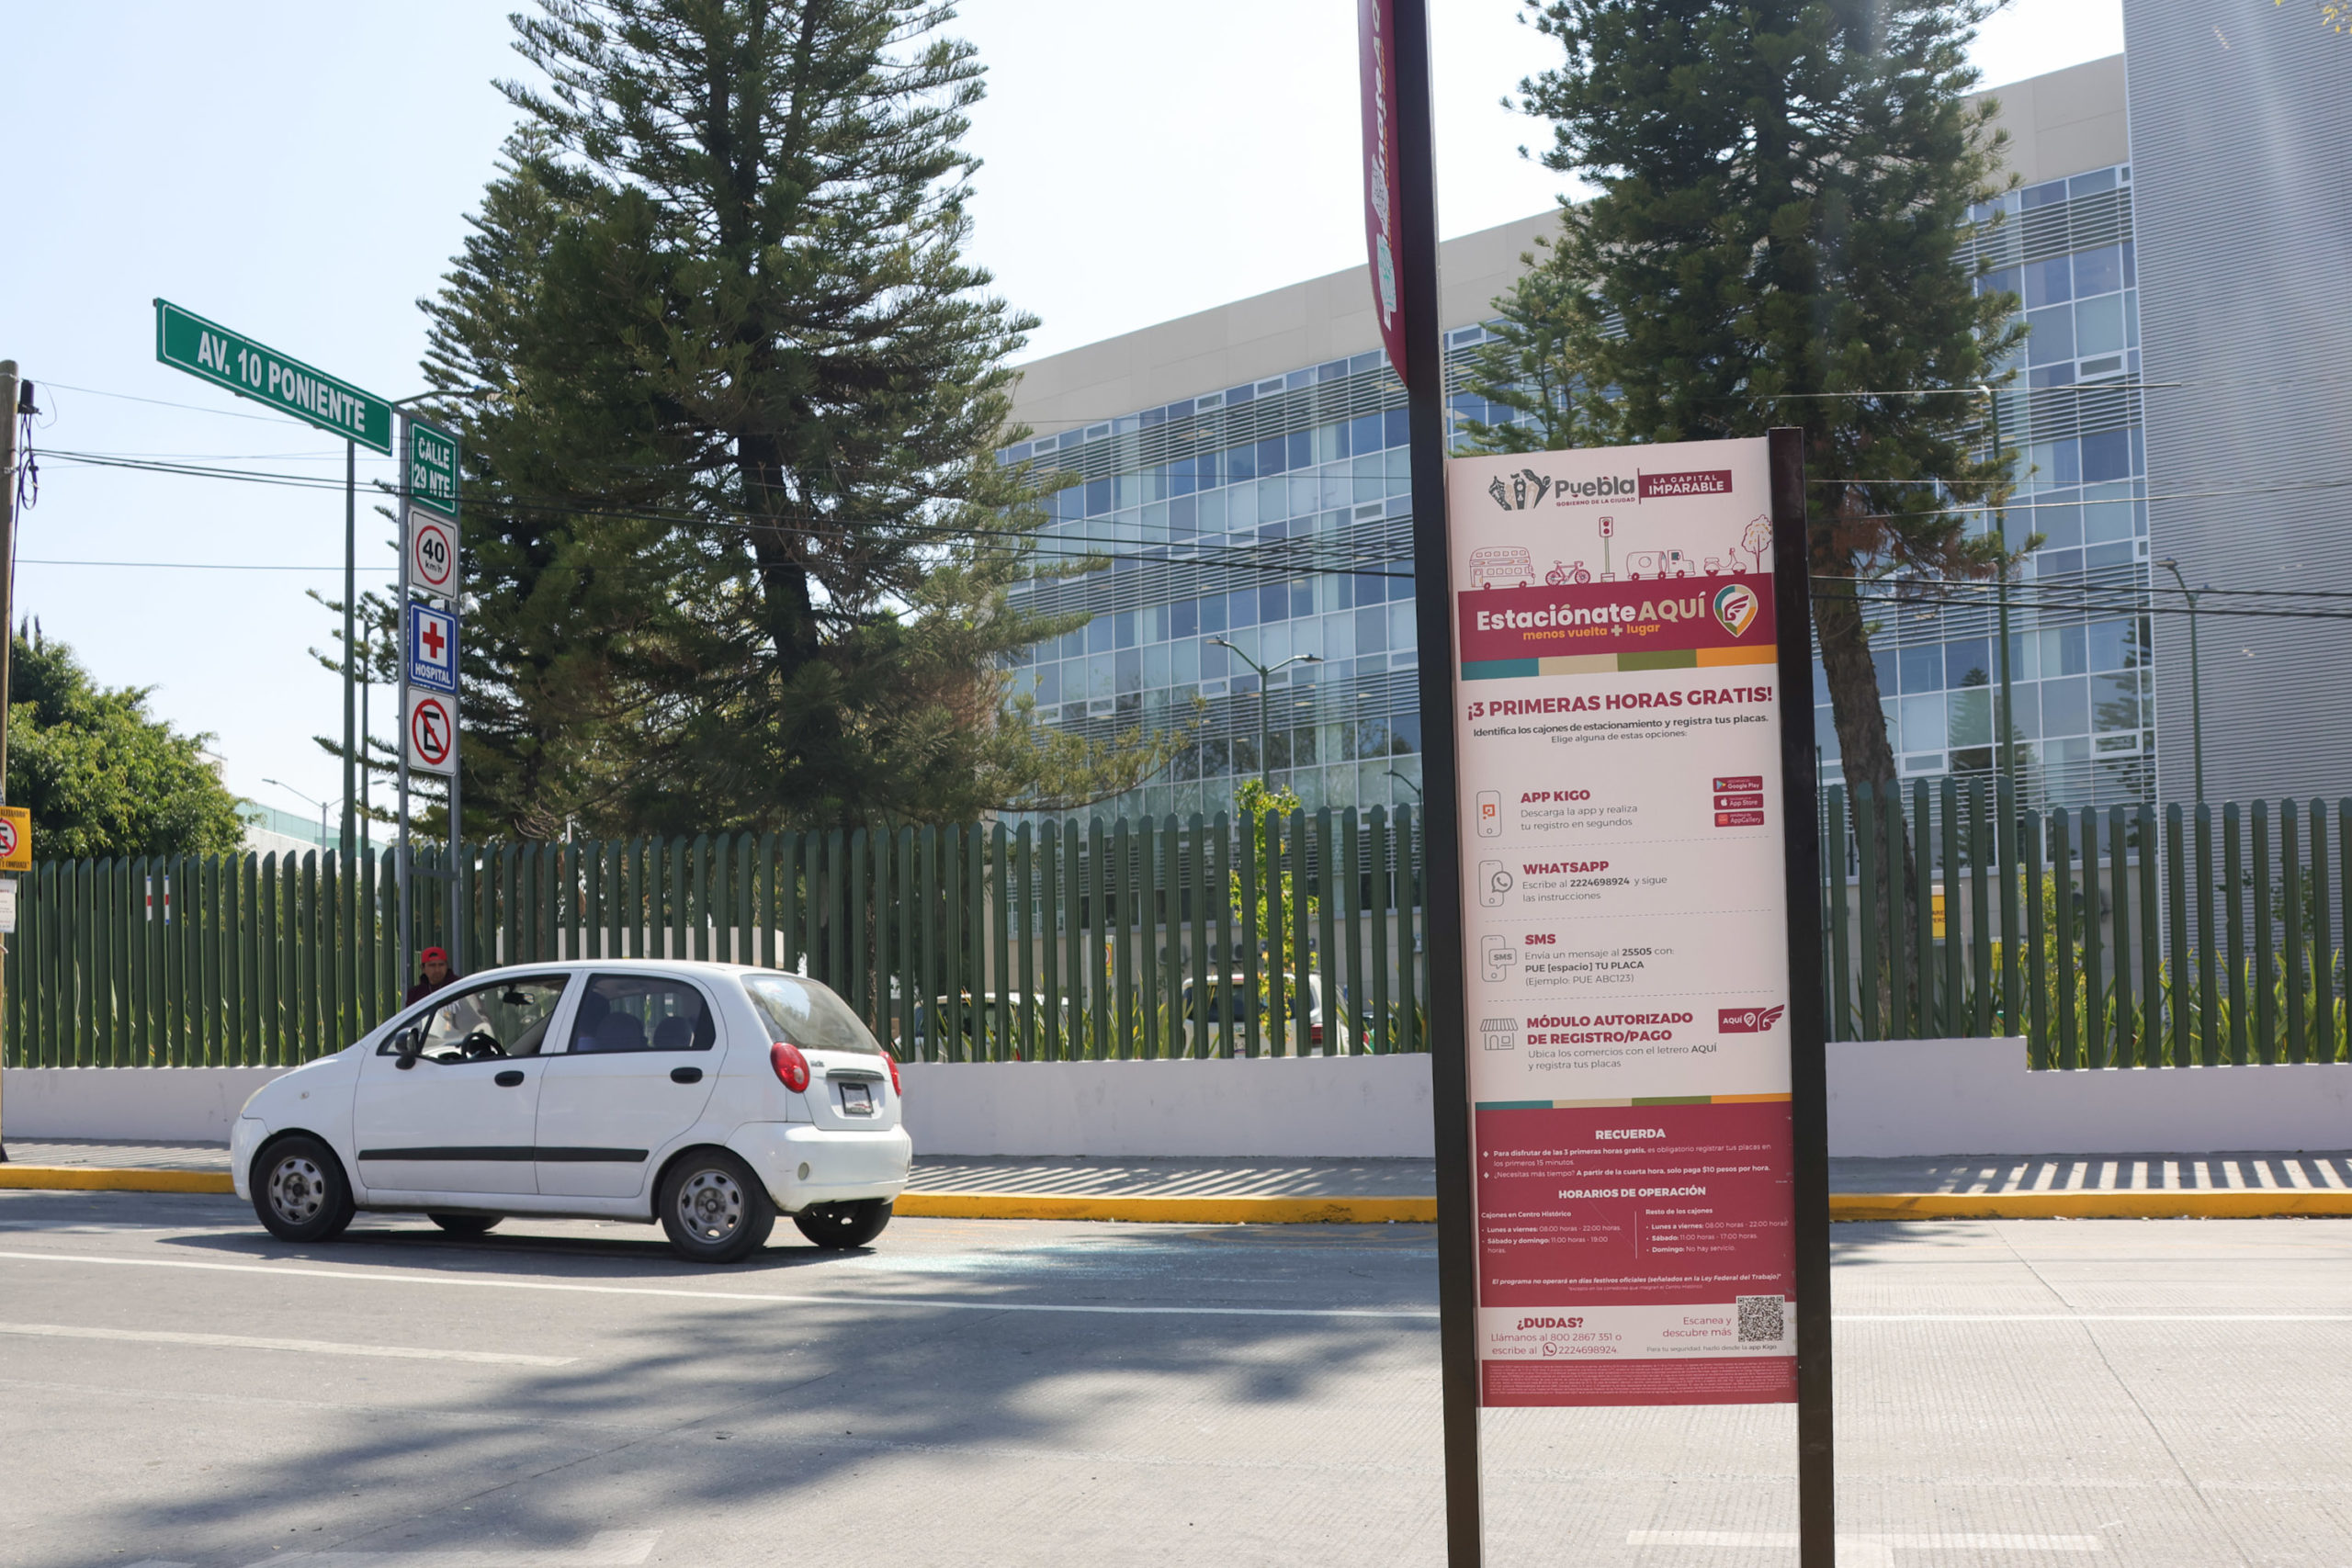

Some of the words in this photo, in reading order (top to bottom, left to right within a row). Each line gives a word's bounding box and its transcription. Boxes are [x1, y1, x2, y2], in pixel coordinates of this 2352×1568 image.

[198, 331, 230, 375] AV.
[238, 348, 262, 388] 10
[268, 360, 366, 433] PONIENTE
[418, 437, 449, 469] CALLE
[413, 464, 427, 490] 29
[429, 471, 454, 499] NTE.
[1670, 475, 1717, 483] CAPITAL
[1555, 476, 1635, 499] Puebla
[1648, 480, 1724, 495] IMPARABLE
[423, 538, 445, 564] 40
[425, 562, 443, 574] km/h
[1523, 630, 1566, 640] menos
[1567, 626, 1607, 637] vuelta
[1627, 624, 1660, 637] lugar
[415, 662, 451, 684] HOSPITAL
[1468, 702, 1485, 721] ¡3
[1489, 695, 1600, 716] PRIMERAS
[1606, 691, 1682, 710] HORAS
[1687, 686, 1772, 705] GRATIS!
[1474, 727, 1517, 737] Identifica
[1518, 726, 1532, 734] los
[1532, 724, 1568, 735] cajones
[1569, 723, 1582, 731] de
[1583, 719, 1663, 731] estacionamiento
[1664, 720, 1671, 728] y
[1673, 716, 1713, 728] registra
[1733, 715, 1769, 725] placas.
[1551, 736, 1574, 744] Elige
[1575, 734, 1605, 743] alguna
[1645, 729, 1687, 739] opciones:
[1521, 792, 1551, 804] APP
[1554, 790, 1590, 802] KIGO
[1521, 809, 1565, 818] Descarga
[1566, 807, 1576, 816] la
[1577, 807, 1597, 817] app
[1599, 807, 1604, 816] y
[1607, 805, 1637, 814] realiza
[1533, 821, 1570, 831] registro
[1586, 818, 1633, 829] segundos
[1522, 861, 1609, 874] WHATSAPP
[1522, 880, 1556, 889] Escribe
[1570, 877, 1630, 887] 2224698924
[1642, 877, 1668, 886] sigue
[1522, 894, 1536, 902] las
[1538, 892, 1601, 902] instrucciones
[1525, 933, 1556, 945] SMS
[1525, 951, 1551, 960] Envía
[1568, 950, 1609, 959] mensaje
[1622, 947, 1652, 956] 25505
[1525, 964, 1545, 973] PUE
[1547, 962, 1593, 974] [espacio]
[1595, 962, 1609, 970] TU
[1611, 961, 1645, 970] PLACA
[1525, 976, 1570, 987] (Ejemplo:
[1573, 976, 1592, 984] PUE
[1595, 974, 1634, 983] ABC123)
[1527, 1014, 1590, 1029] MÓDULO
[1593, 1012, 1693, 1026] AUTORIZADO
[1723, 1015, 1742, 1024] AQUÍ
[1527, 1033, 1547, 1045] DE
[1550, 1030, 1672, 1044] REGISTRO/PAGO
[1528, 1050, 1555, 1058] Ubica
[1558, 1049, 1572, 1057] los
[1573, 1047, 1623, 1057] comercios
[1645, 1046, 1655, 1055] el
[1657, 1045, 1689, 1055] letrero
[1690, 1043, 1716, 1054] AQUÍ
[1528, 1064, 1534, 1072] y
[1536, 1062, 1571, 1071] registra
[1590, 1059, 1622, 1069] placas
[1595, 1128, 1667, 1140] RECUERDA
[1569, 1148, 1601, 1156] primeras
[1558, 1189, 1619, 1199] HORARIOS
[1621, 1188, 1636, 1198] DE
[1638, 1185, 1706, 1197] OPERACIÓN
[1517, 1317, 1583, 1331] ¿DUDAS?
[1683, 1316, 1724, 1325] Escanea
[1725, 1318, 1732, 1326] y
[1491, 1333, 1537, 1342] Llámanos
[1539, 1333, 1548, 1341] al
[1550, 1333, 1570, 1341] 800
[1572, 1333, 1596, 1341] 2867
[1599, 1333, 1612, 1341] 351
[1662, 1328, 1708, 1337] descubre
[1711, 1327, 1732, 1337] más
[1491, 1346, 1527, 1355] escribe
[1529, 1346, 1537, 1355] al
